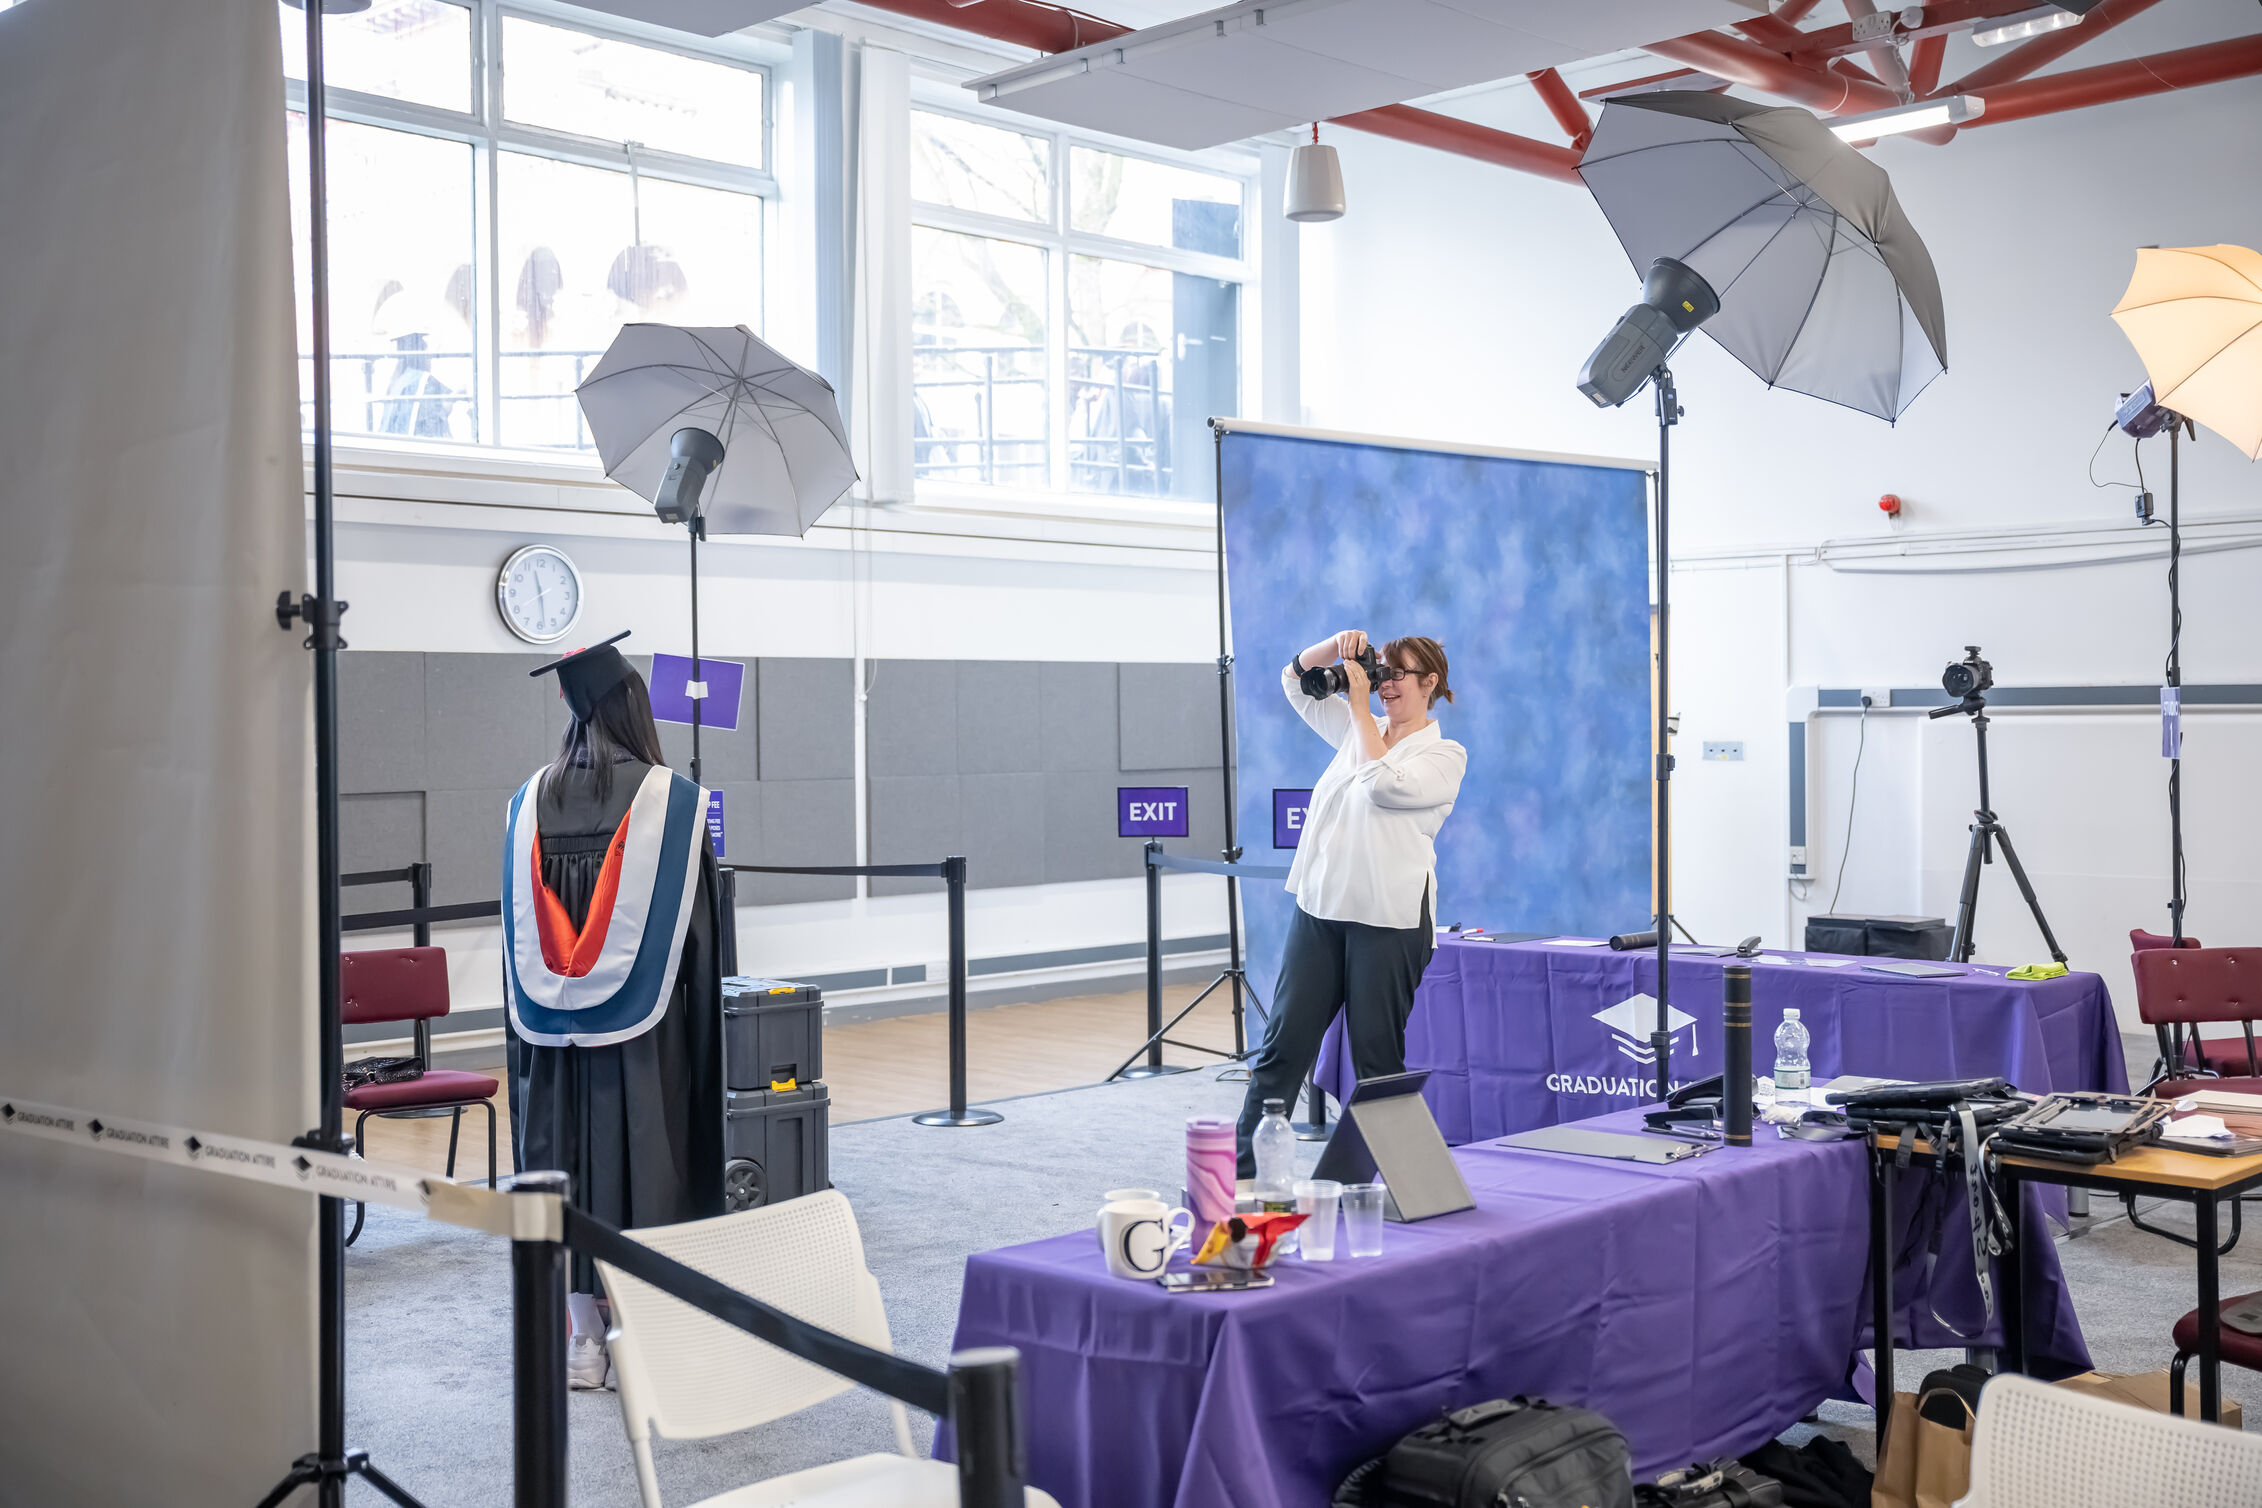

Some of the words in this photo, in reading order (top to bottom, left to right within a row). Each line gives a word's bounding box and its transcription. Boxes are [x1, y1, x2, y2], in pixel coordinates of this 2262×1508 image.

[1621, 343, 1646, 374] NEEWER
[536, 559, 546, 568] 12
[514, 574, 524, 583] 10
[560, 575, 567, 585] 2
[509, 588, 516, 597] 9
[564, 591, 570, 600] 3
[513, 605, 520, 614] 8
[559, 607, 566, 616] 4
[523, 617, 530, 626] 7
[536, 621, 544, 630] 6
[550, 617, 557, 627] 5
[1129, 802, 1178, 822] EXIT
[17, 1111, 54, 1127] GRADUATION
[55, 1118, 75, 1131] ATTIRE
[106, 1127, 147, 1145] GRADUATION
[148, 1135, 170, 1150] ATTIRE
[205, 1145, 250, 1164] GRADUATION
[252, 1153, 276, 1169] ATTIRE
[316, 1164, 368, 1186] GRADUATION
[370, 1175, 397, 1192] ATTIRE
[1119, 1217, 1166, 1273] G
